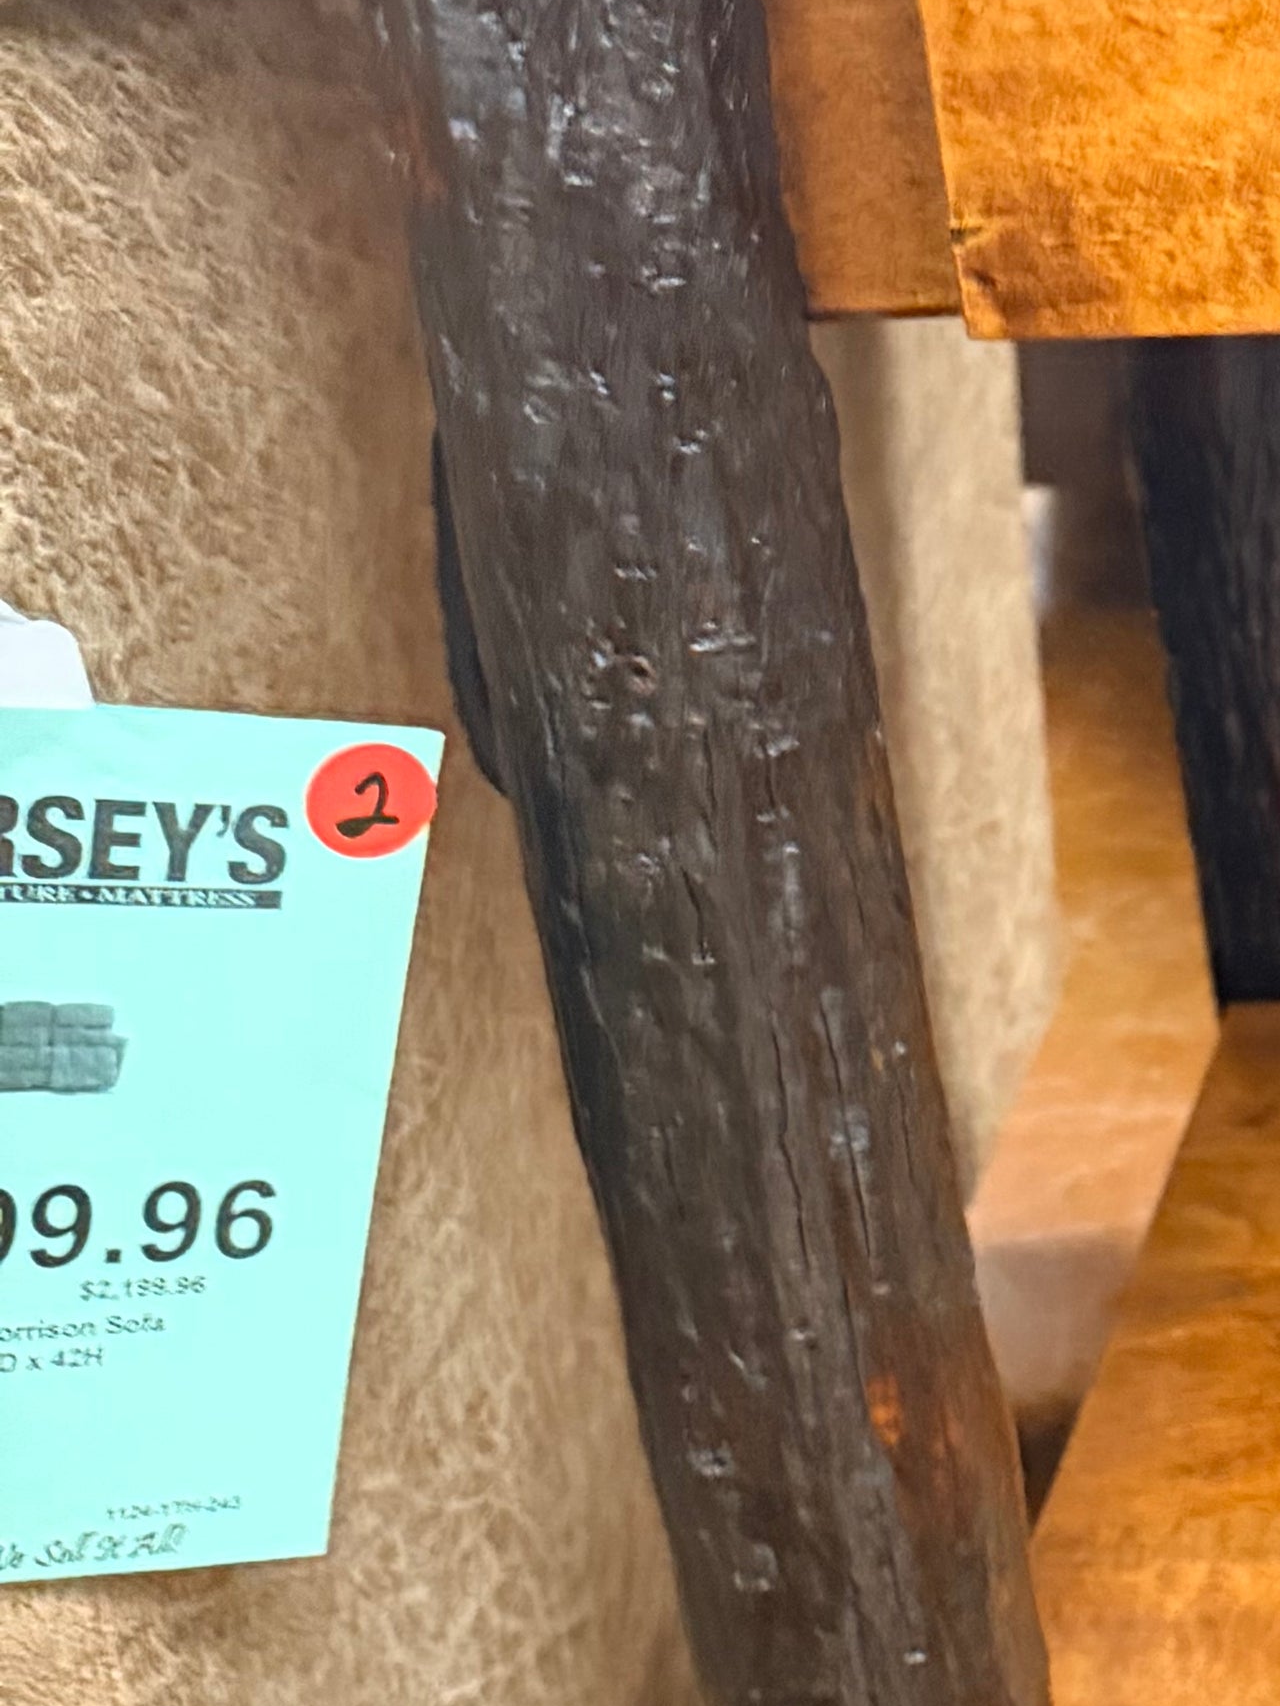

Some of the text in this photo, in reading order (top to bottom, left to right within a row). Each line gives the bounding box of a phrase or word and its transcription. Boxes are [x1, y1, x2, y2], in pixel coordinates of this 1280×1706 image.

[335, 771, 400, 839] 2
[0, 883, 75, 904] URE
[104, 1313, 166, 1335] Sofa
[26, 1355, 42, 1371] x
